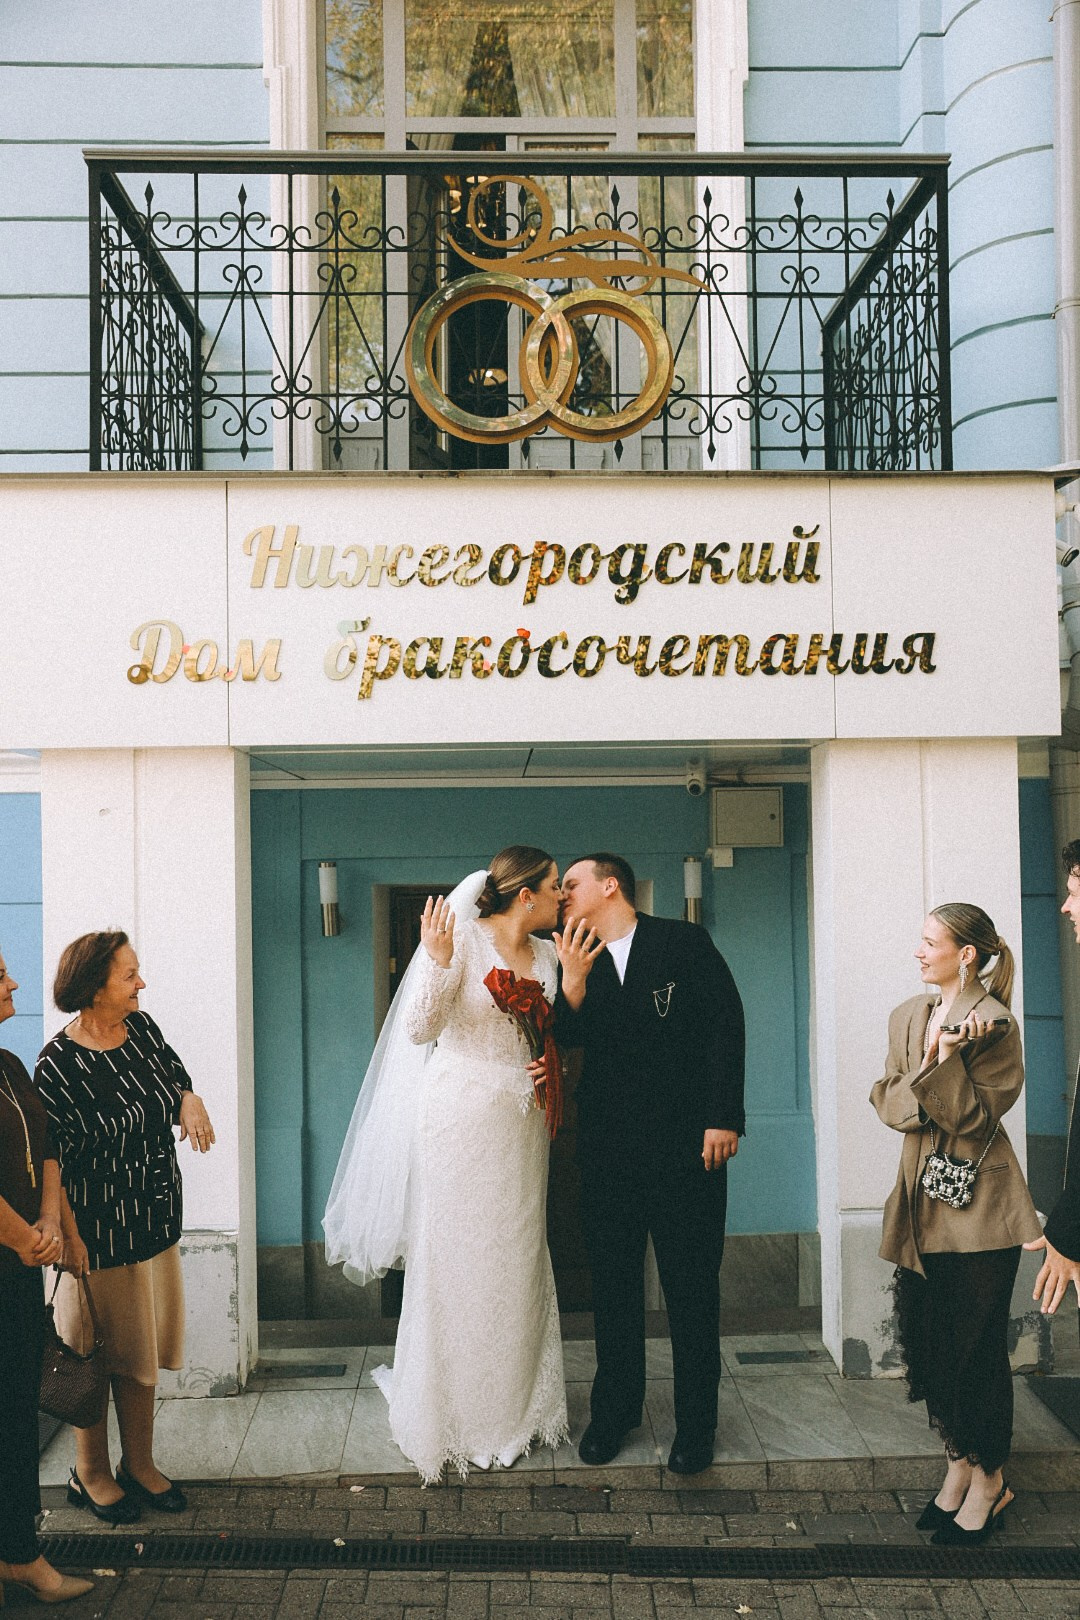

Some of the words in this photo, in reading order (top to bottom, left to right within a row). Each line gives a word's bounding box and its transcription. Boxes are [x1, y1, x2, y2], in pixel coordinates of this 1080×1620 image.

[242, 524, 821, 606] Нижегородский
[127, 619, 282, 685] Дом
[323, 616, 937, 701] бракосочетания
